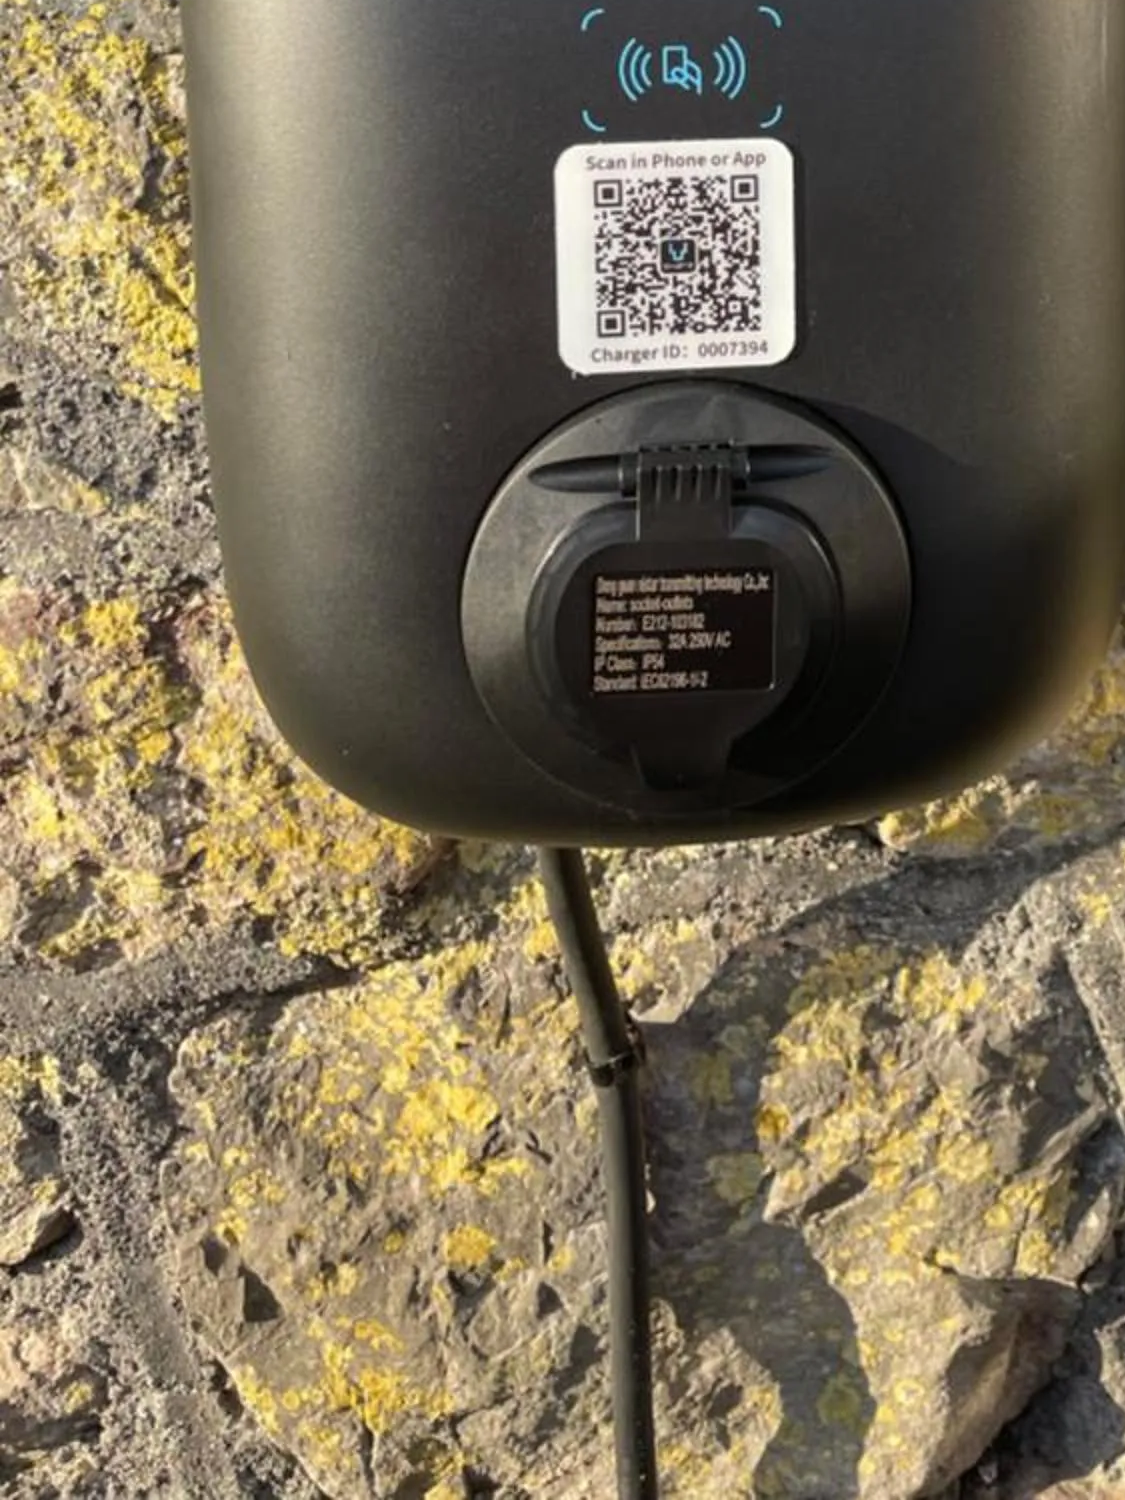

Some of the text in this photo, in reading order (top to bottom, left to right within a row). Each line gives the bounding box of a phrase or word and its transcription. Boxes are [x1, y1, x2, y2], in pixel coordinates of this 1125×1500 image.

[586, 150, 767, 171] Scan in Phone or App
[590, 345, 660, 364] Charger
[697, 339, 769, 358] 0007394
[714, 630, 732, 649] AC
